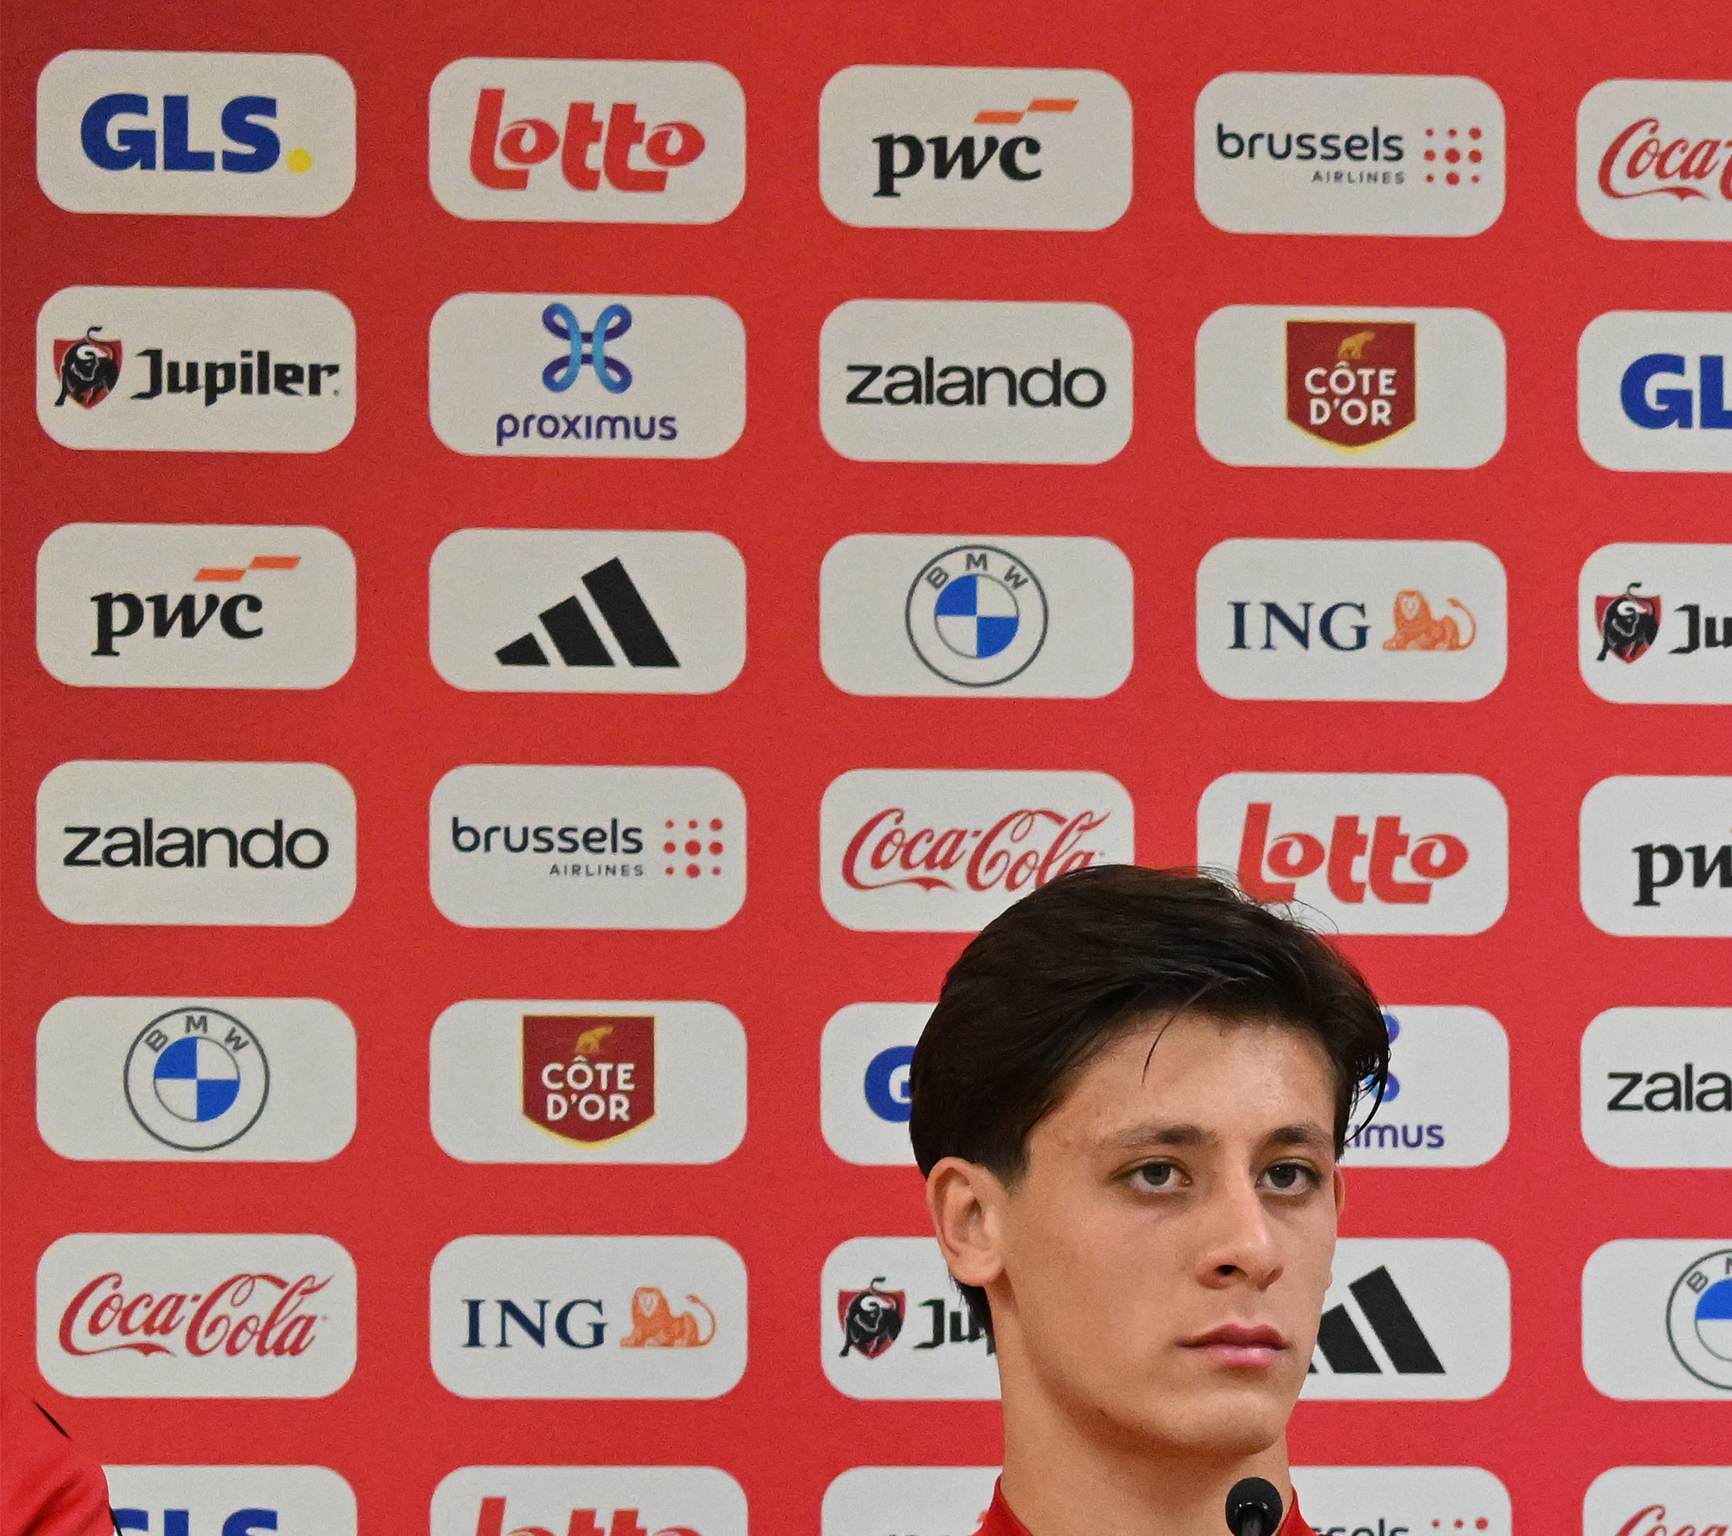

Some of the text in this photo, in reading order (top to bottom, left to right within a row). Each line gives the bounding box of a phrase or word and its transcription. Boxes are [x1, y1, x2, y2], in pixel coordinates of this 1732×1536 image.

[1215, 121, 1405, 163] brussels
[871, 133, 1042, 198] pwc
[1311, 169, 1405, 185] AIRLINES
[129, 348, 340, 408] Jupiler
[845, 355, 1107, 409] zalando
[1305, 361, 1396, 396] CÔTE
[496, 413, 678, 447] proximus
[921, 547, 1031, 591] BMW
[89, 592, 264, 657] pwc
[1227, 601, 1372, 653] ING
[62, 816, 330, 870] zalando
[451, 815, 644, 856] brussels
[549, 863, 644, 878] AIRLINES
[140, 1009, 252, 1054] BMW
[541, 1055, 635, 1091] CÔTE
[57, 1272, 332, 1358] Coca-Cola
[461, 1298, 609, 1350] ING
